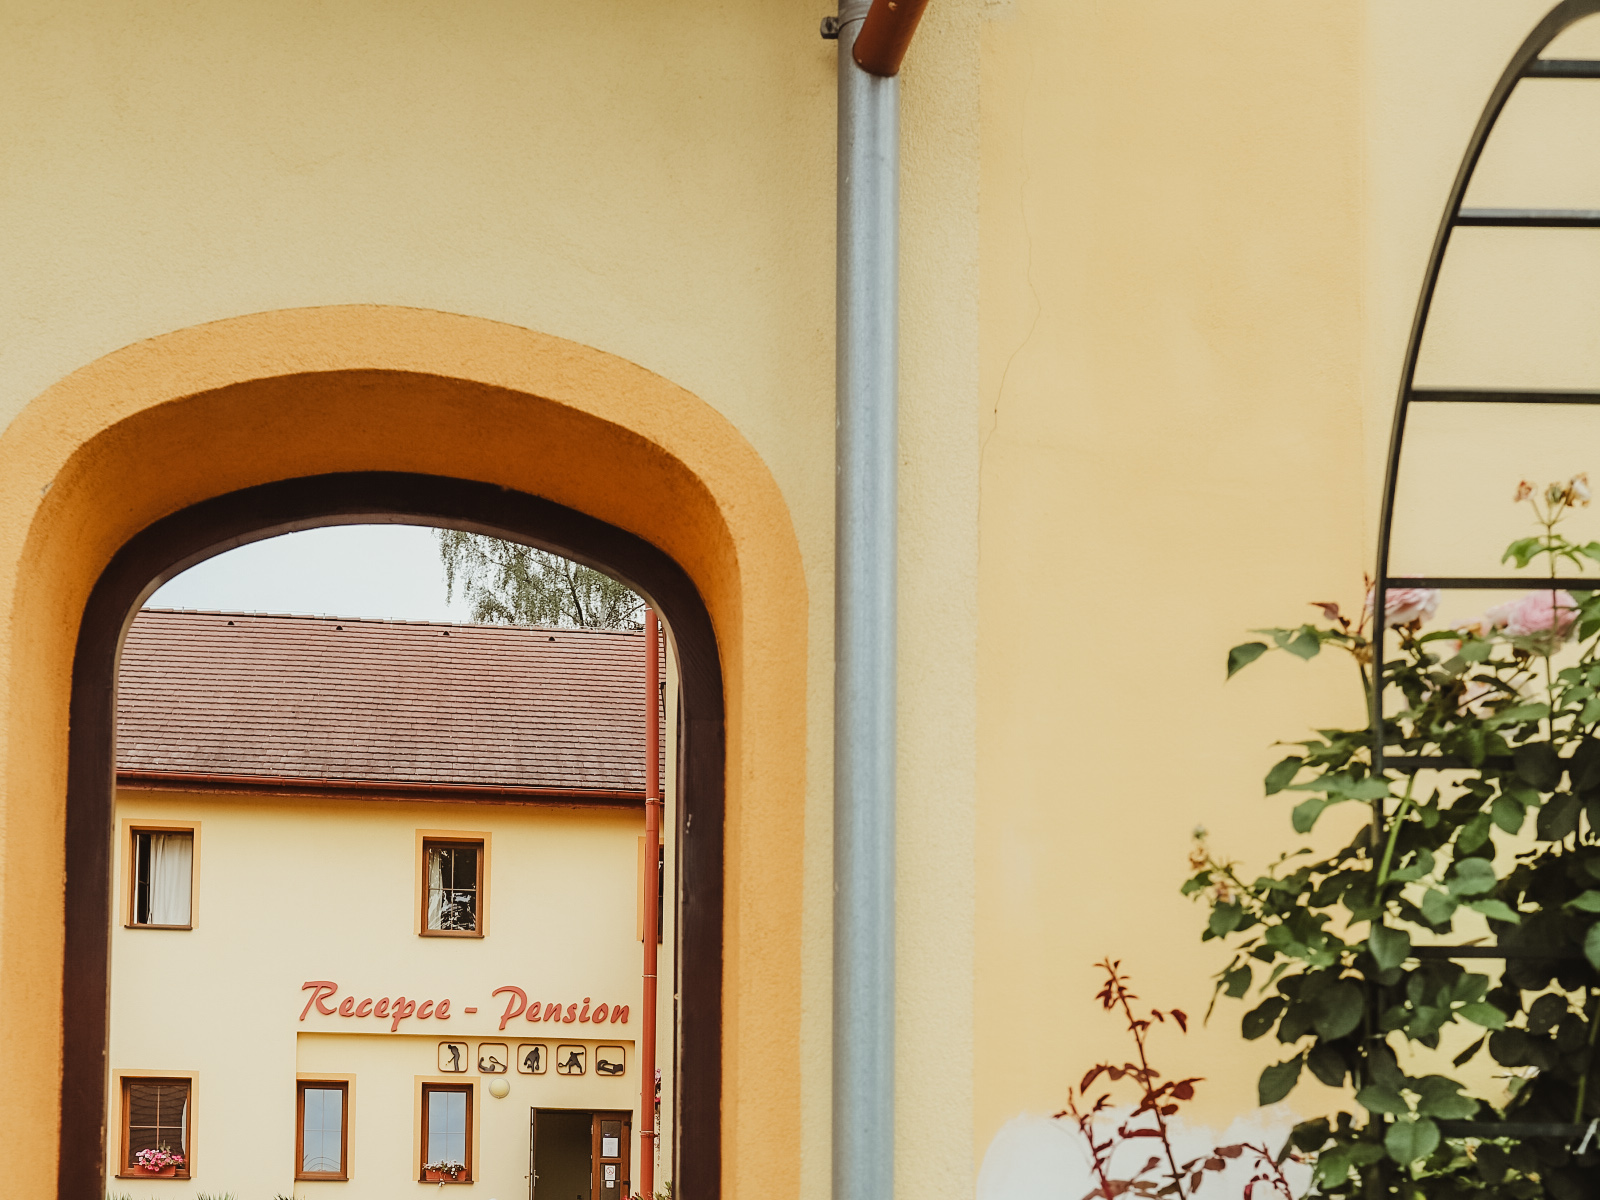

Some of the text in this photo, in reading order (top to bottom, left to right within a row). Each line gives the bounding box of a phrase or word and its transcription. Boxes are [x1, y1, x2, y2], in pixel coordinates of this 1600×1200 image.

[299, 980, 630, 1031] Recepce - Pension
